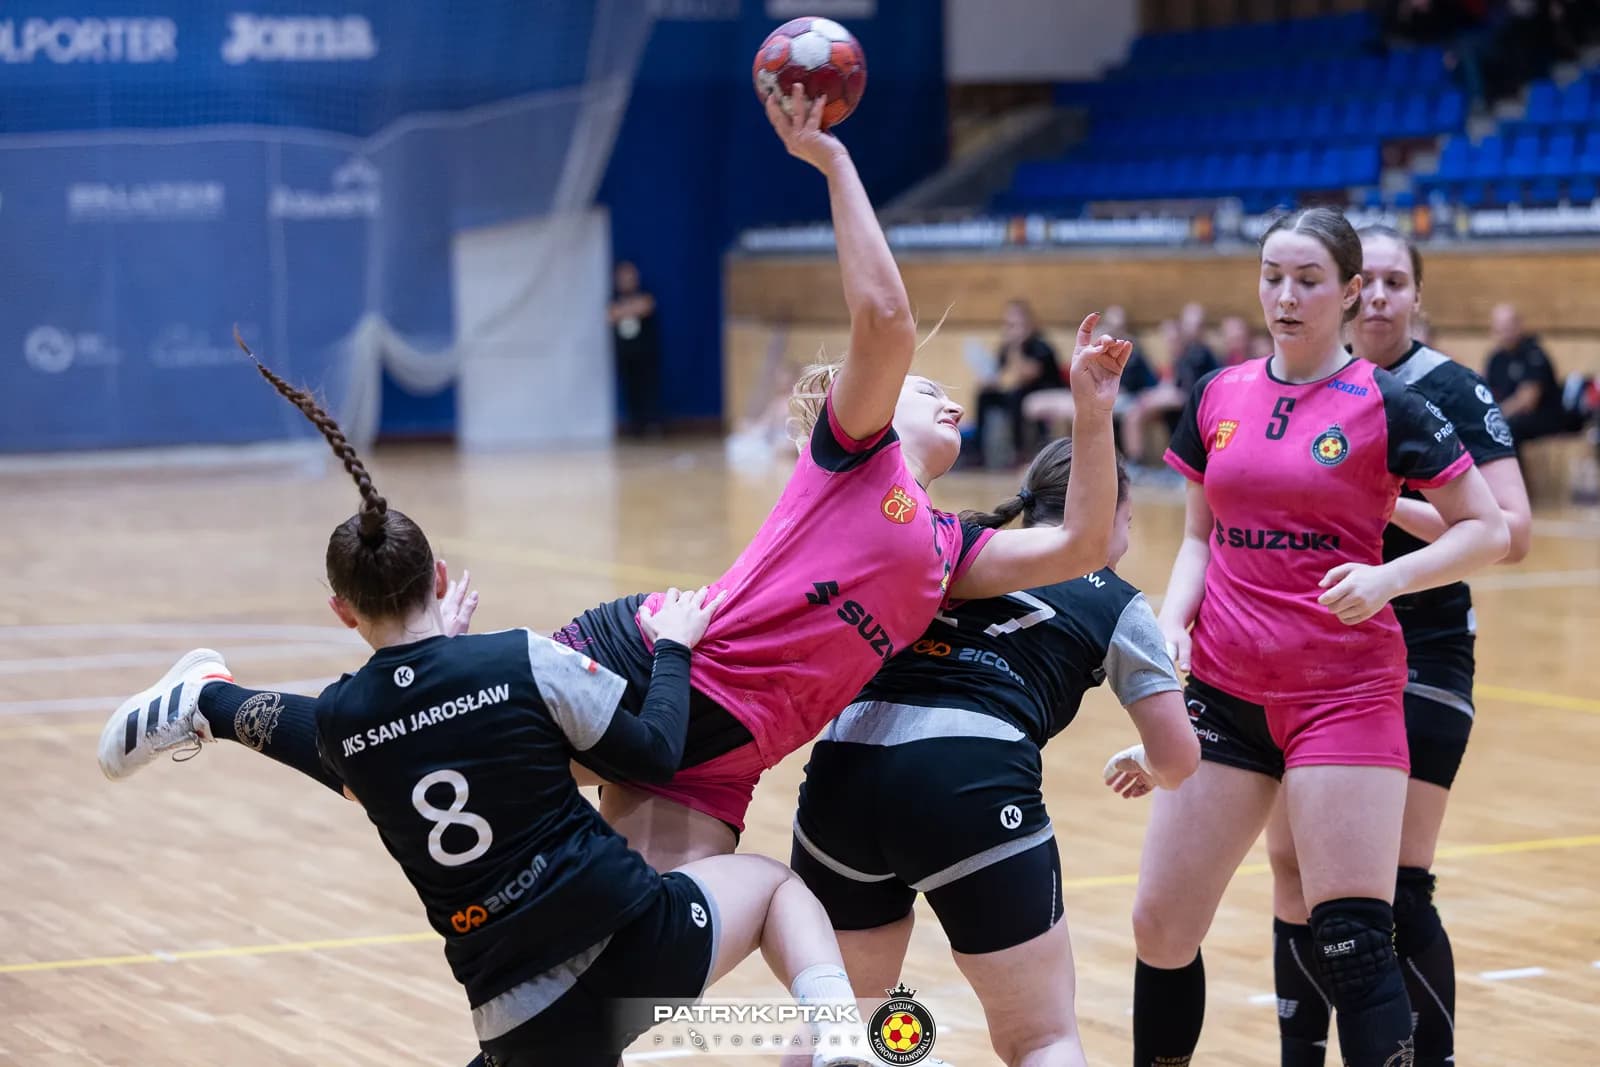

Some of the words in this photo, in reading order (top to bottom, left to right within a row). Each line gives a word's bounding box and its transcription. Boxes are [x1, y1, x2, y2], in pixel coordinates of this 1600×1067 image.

[0, 17, 178, 63] LPORTER
[1265, 396, 1296, 440] 5
[884, 499, 910, 522] CK
[1228, 527, 1340, 551] SUZUKI
[342, 734, 366, 757] JKS
[367, 718, 407, 746] SAN
[410, 683, 509, 732] JAROSŁAW
[411, 769, 493, 867] 8
[1323, 939, 1355, 954] SELECT
